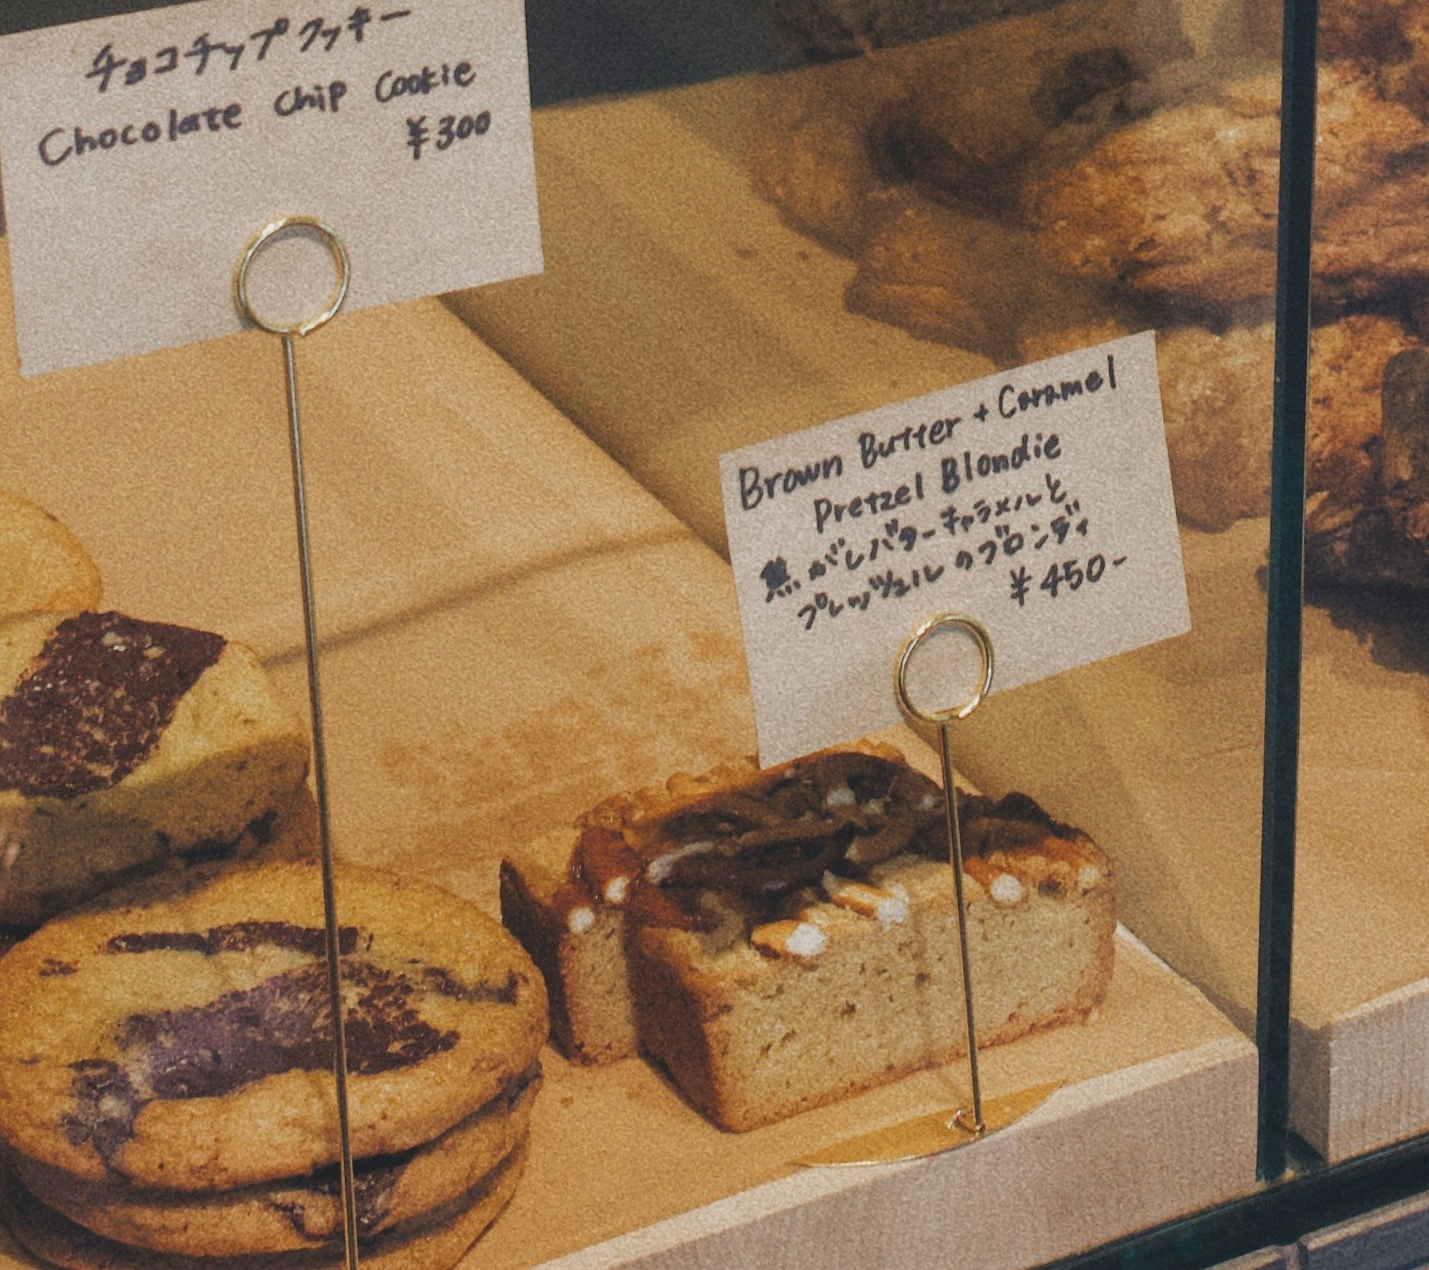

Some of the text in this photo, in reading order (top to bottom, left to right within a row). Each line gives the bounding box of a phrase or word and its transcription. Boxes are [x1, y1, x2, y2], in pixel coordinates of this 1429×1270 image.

[85, 4, 413, 94] チョコチップクッキー
[38, 101, 245, 166] Chocolate
[375, 59, 477, 105] Cookie
[405, 108, 493, 159] ¥300
[738, 453, 844, 511] Brown
[858, 415, 963, 469] Butter
[998, 355, 1118, 420] Caramel
[814, 431, 1063, 534] Pretzel Blondie
